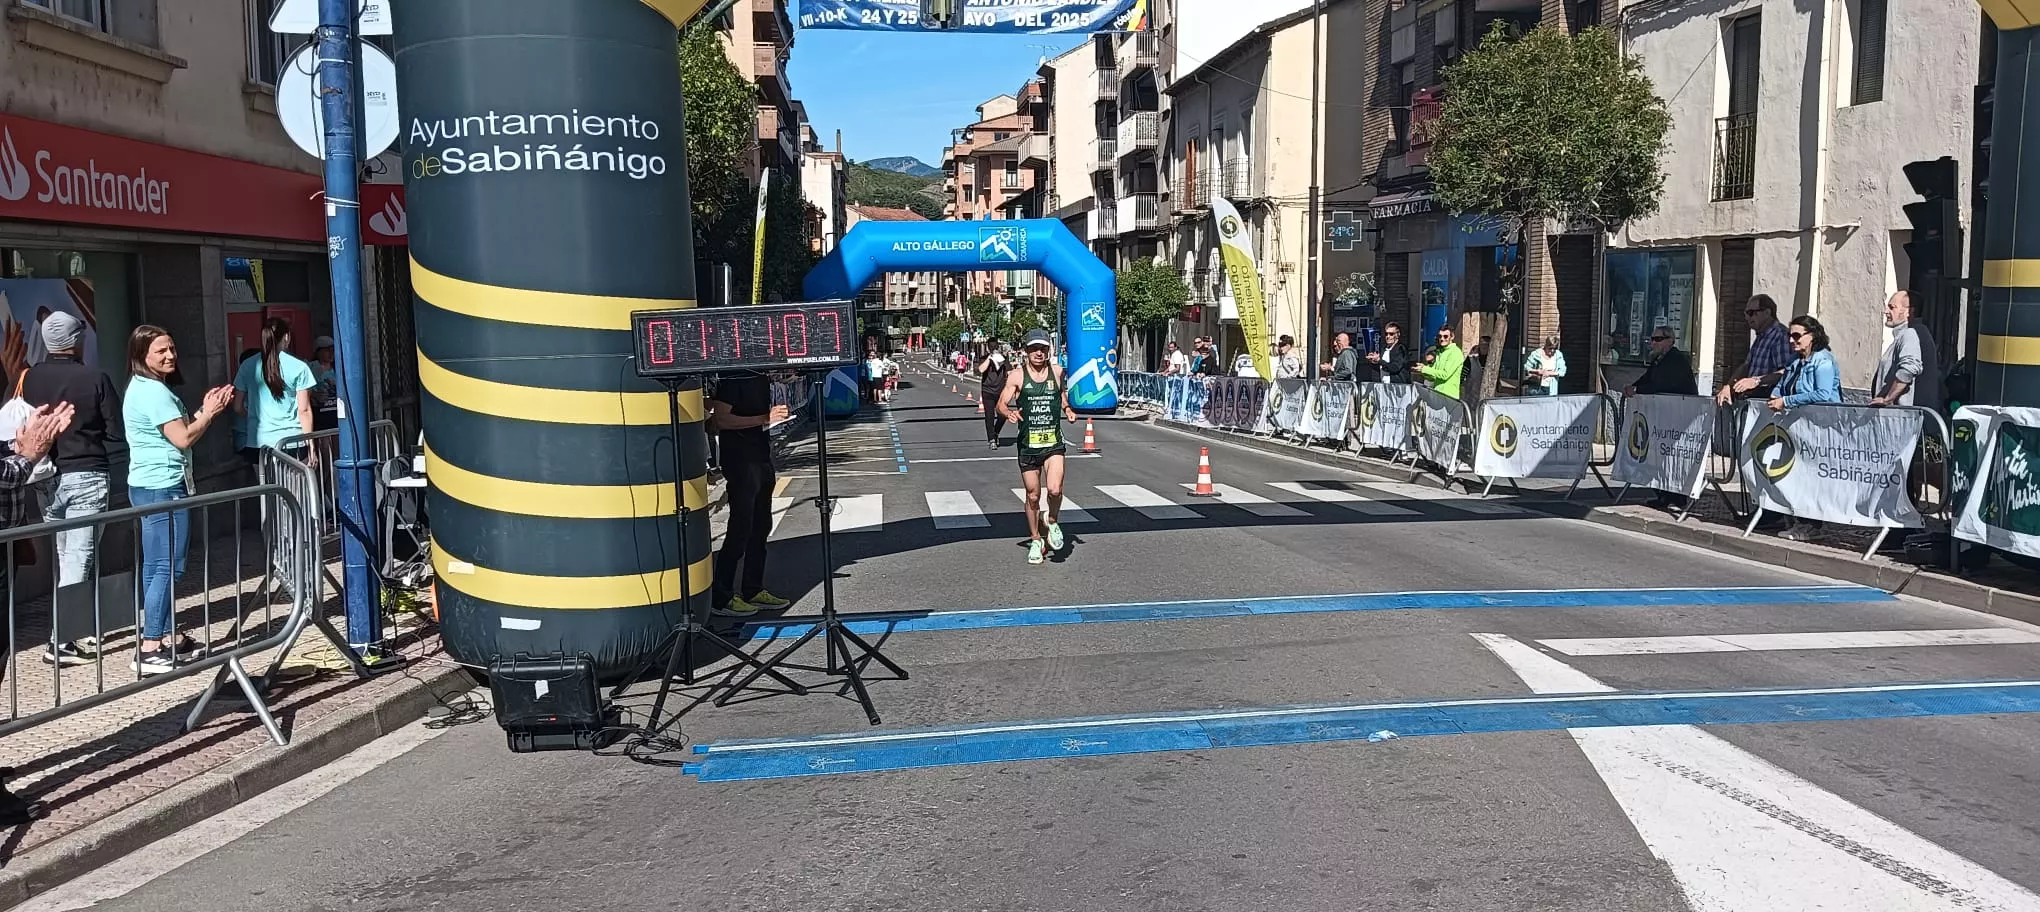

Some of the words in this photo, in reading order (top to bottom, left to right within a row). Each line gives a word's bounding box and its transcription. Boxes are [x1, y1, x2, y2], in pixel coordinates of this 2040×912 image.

[861, 10, 881, 25] 24
[883, 10, 895, 25] Y
[898, 11, 918, 25] 25
[963, 12, 997, 27] AYO
[1014, 13, 1047, 27] DEL
[1051, 13, 1091, 27] 2025
[409, 108, 660, 148] Ayuntamiento
[35, 150, 169, 215] Santander
[1373, 200, 1431, 218] FARMACIA
[892, 241, 921, 252] ALTO
[923, 240, 975, 251] GÁLLEGO
[1020, 227, 1028, 261] COMARCA
[1030, 405, 1051, 413] JACA
[1038, 433, 1049, 441] 78
[1520, 424, 1590, 437] Ayuntamiento
[1531, 438, 1590, 452] Sabiñánigo
[1799, 438, 1900, 464] Ayuntamient
